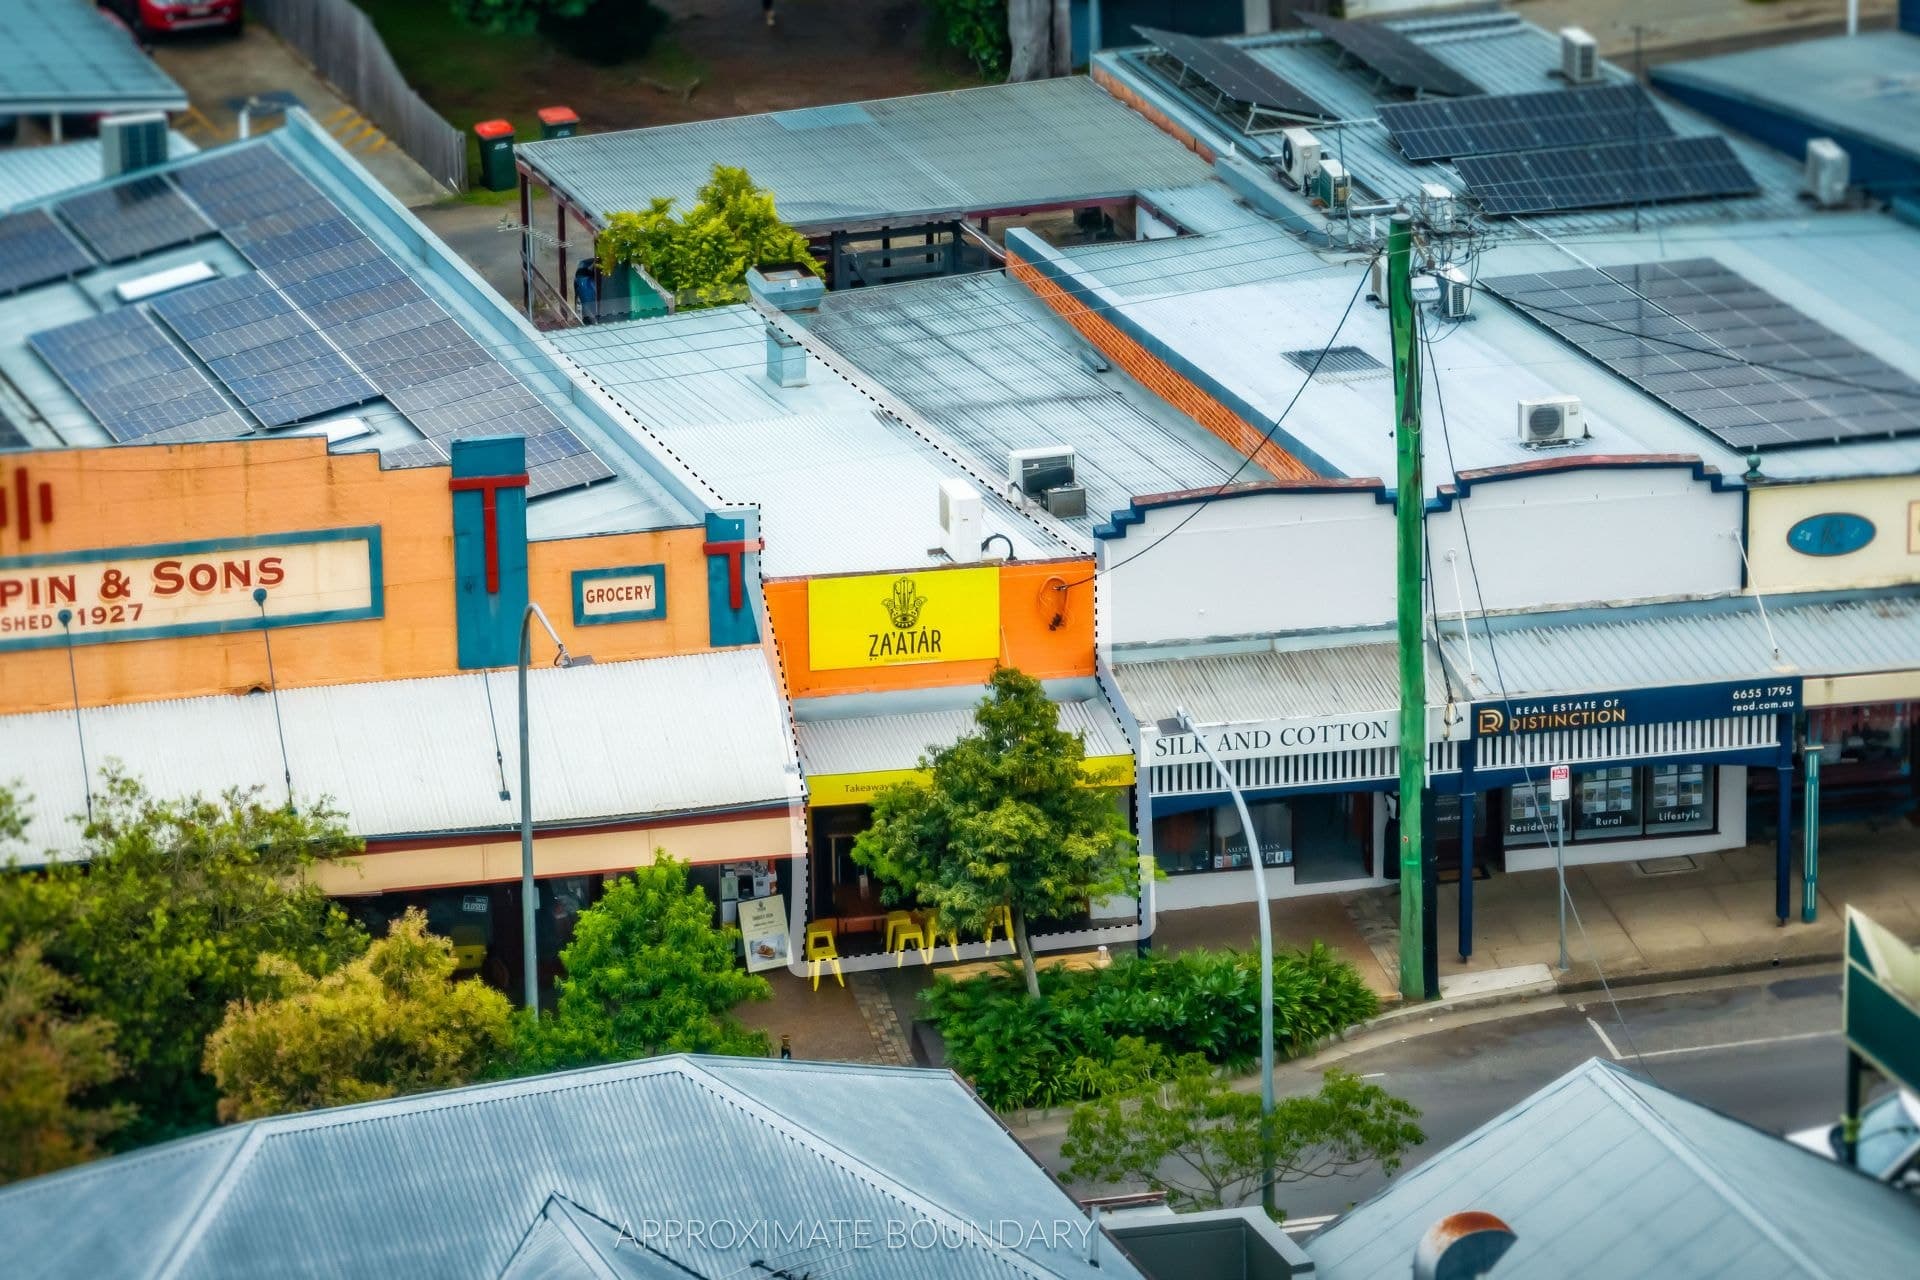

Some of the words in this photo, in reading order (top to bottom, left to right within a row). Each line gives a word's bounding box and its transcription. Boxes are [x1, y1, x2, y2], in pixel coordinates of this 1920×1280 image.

[0, 575, 77, 608] PIN
[100, 569, 131, 600] &
[586, 585, 652, 604] GROCERY
[1, 614, 53, 632] SHED
[77, 603, 145, 627] 1927
[1732, 689, 1762, 700] 6655
[1767, 685, 1793, 697] 1795
[1515, 705, 1546, 716] REAL
[1552, 700, 1597, 713] ESTATE
[1603, 698, 1620, 709] OF
[1732, 700, 1795, 712] reod.com.au
[1509, 708, 1627, 732] DISTINCTION
[1154, 734, 1210, 757] SILK
[1217, 729, 1271, 752] AND
[1280, 720, 1389, 746] COTTON
[844, 783, 890, 793] Takeaway
[1595, 815, 1622, 826] Rural
[1658, 810, 1701, 823] Lifestyle
